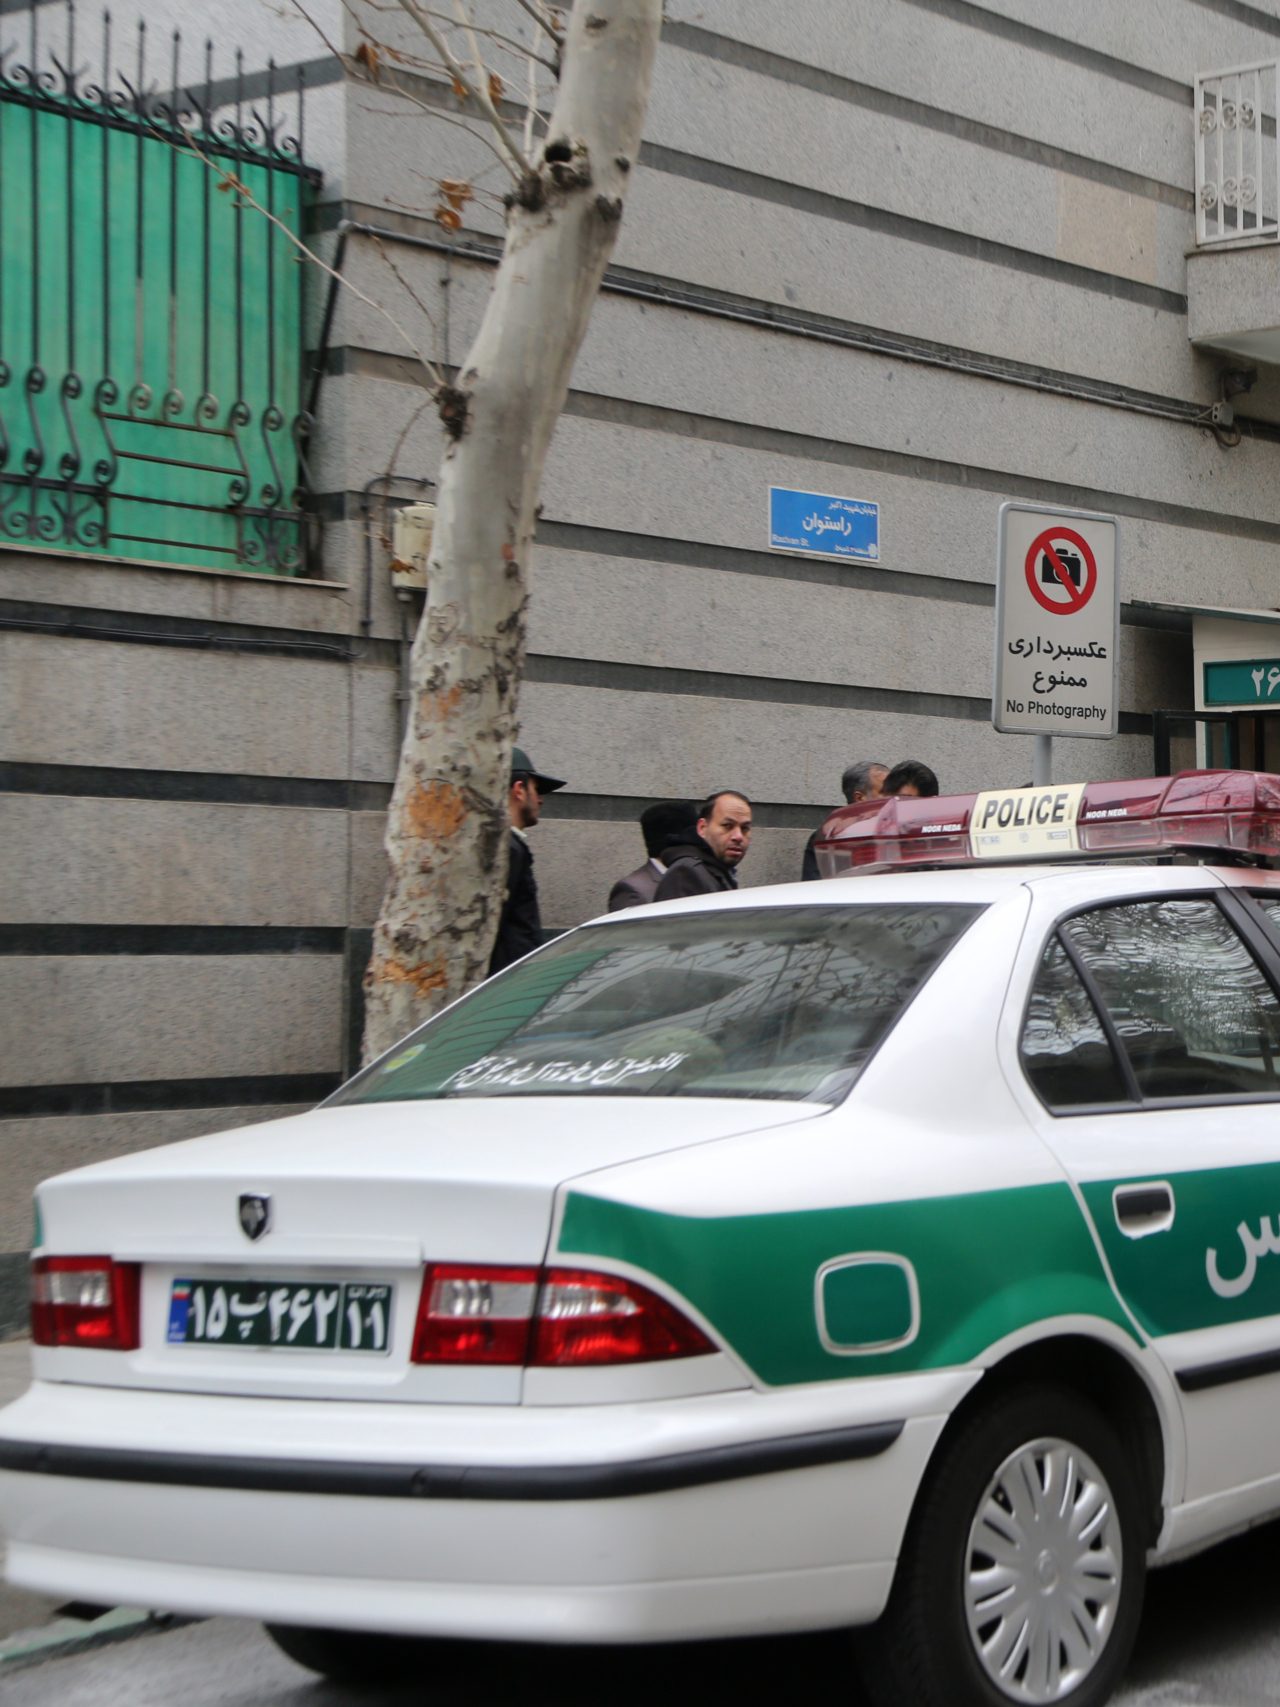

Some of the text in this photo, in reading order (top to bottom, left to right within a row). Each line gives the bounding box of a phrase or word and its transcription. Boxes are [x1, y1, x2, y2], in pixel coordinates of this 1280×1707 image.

[802, 512, 852, 536] راستوان
[1008, 636, 1107, 661] عکسبرداری
[1033, 670, 1087, 694] ممنوع
[1006, 700, 1107, 721] No Photography
[982, 793, 1069, 829] POLICE
